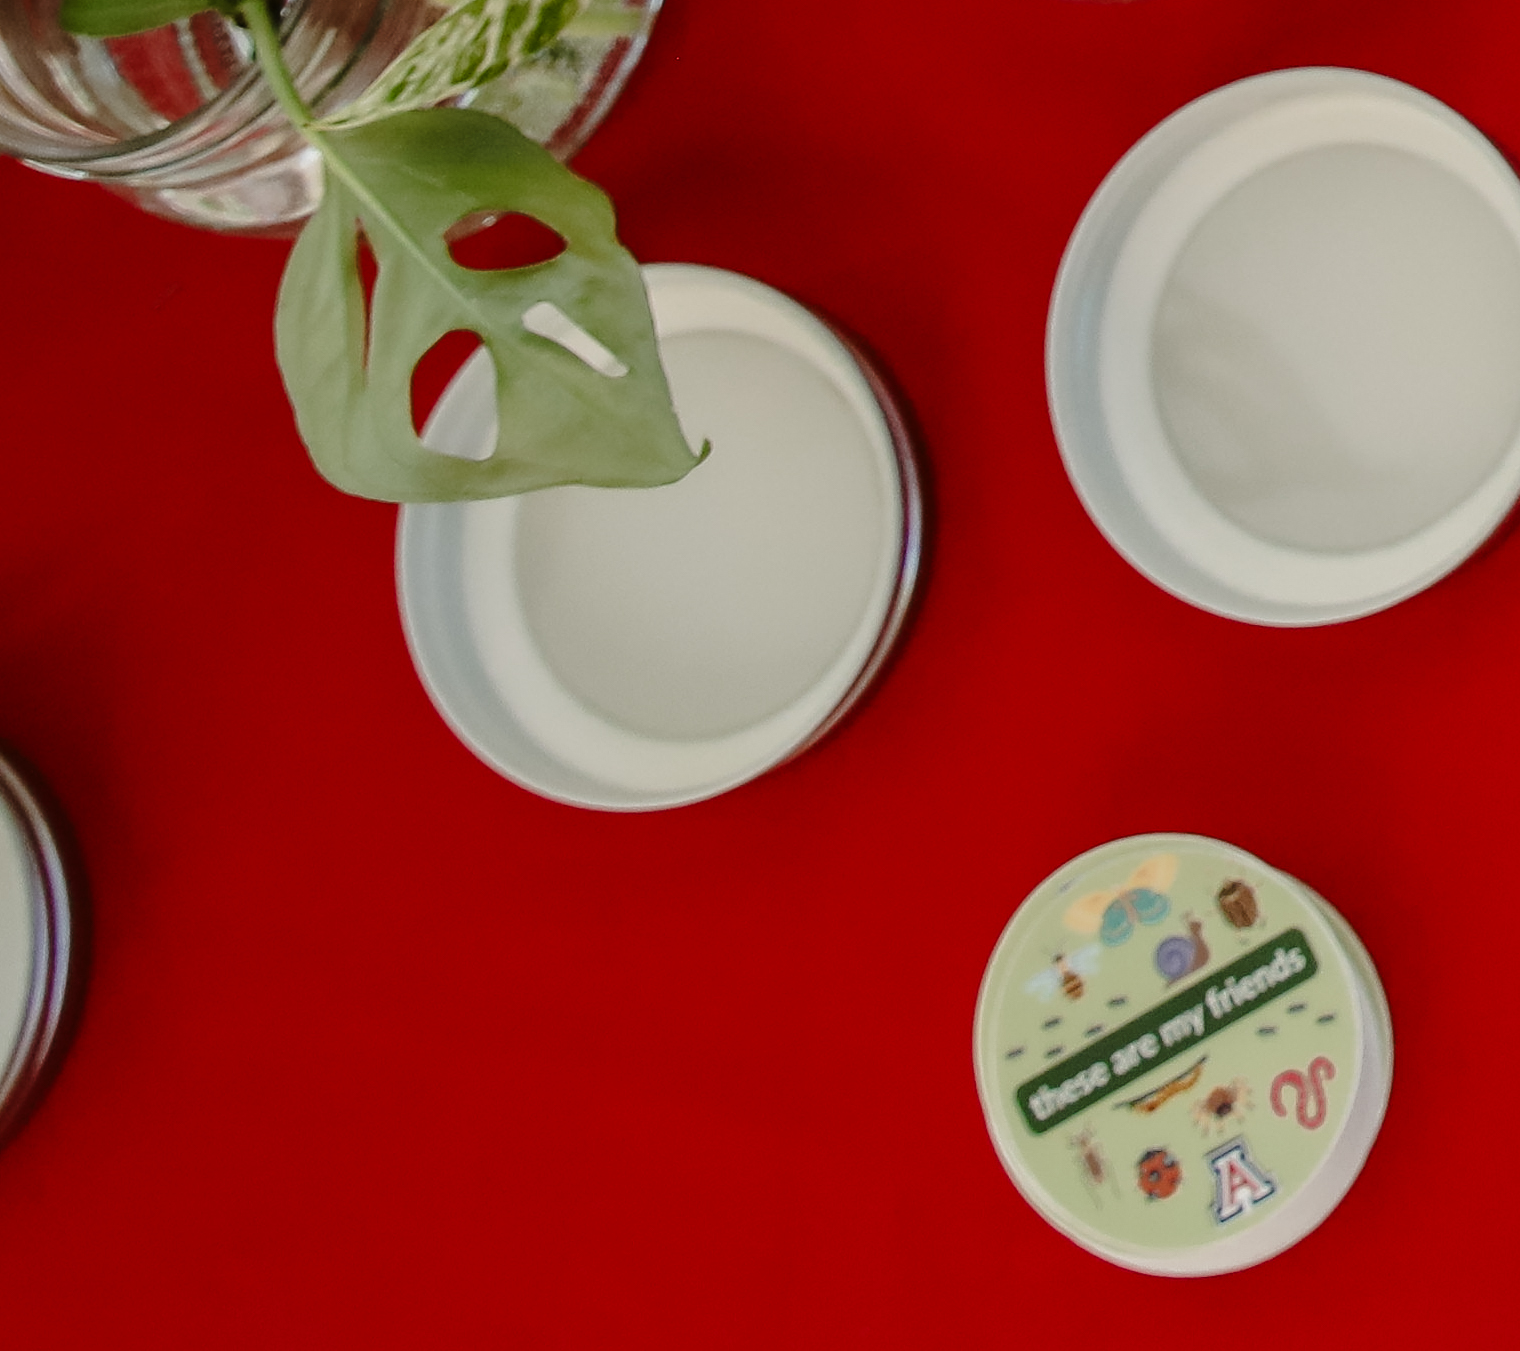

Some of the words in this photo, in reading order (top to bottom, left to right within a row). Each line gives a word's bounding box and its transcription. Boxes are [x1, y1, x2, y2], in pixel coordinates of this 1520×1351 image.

[1028, 1060, 1111, 1121] these
[1109, 1032, 1161, 1077] are
[1157, 1003, 1207, 1048] my
[1204, 946, 1308, 1020] friends
